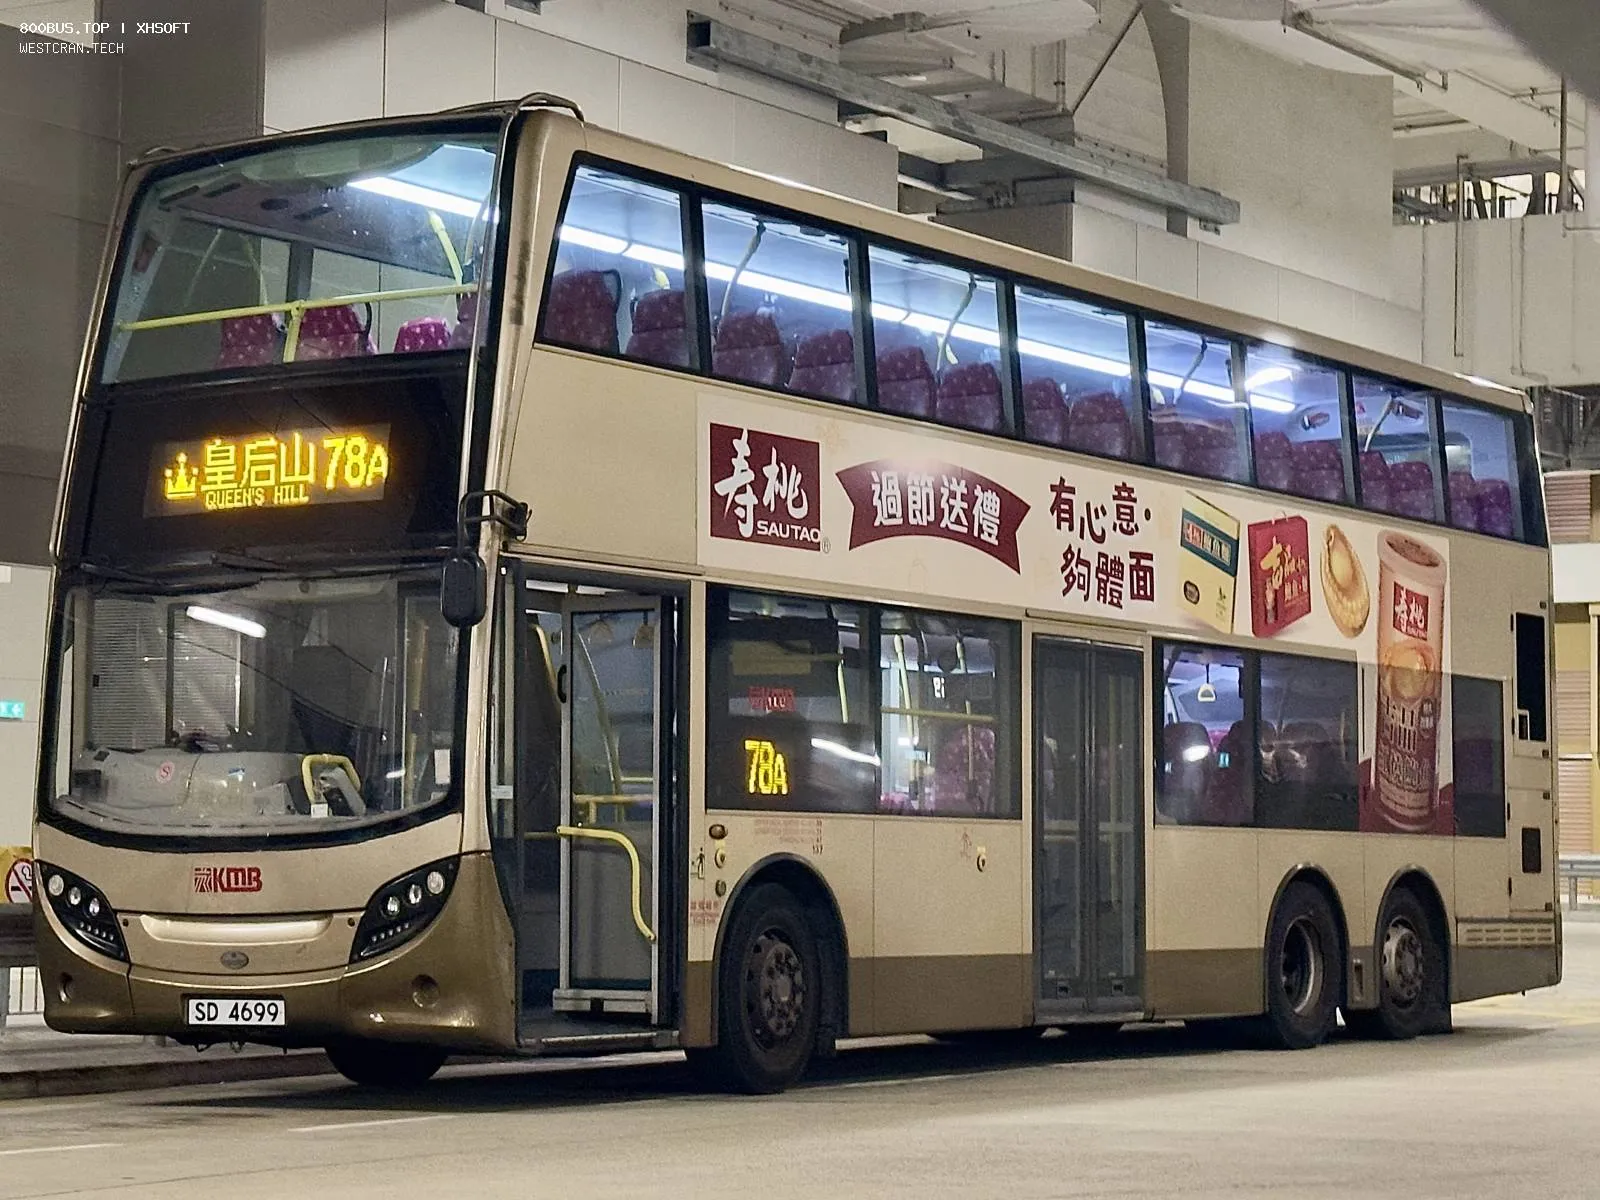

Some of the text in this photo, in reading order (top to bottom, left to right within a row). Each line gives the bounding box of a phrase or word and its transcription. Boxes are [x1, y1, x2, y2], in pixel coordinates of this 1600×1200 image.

[201, 432, 389, 492] 皇后山 78A
[205, 484, 310, 510] QUEEN'S HILL
[871, 470, 1001, 546] 過節送禮
[756, 520, 821, 543] SAUTAO
[1060, 543, 1155, 610] 夠體面
[744, 739, 789, 796] 78A
[213, 867, 263, 893] KMB
[195, 1002, 279, 1022] SD 4699
